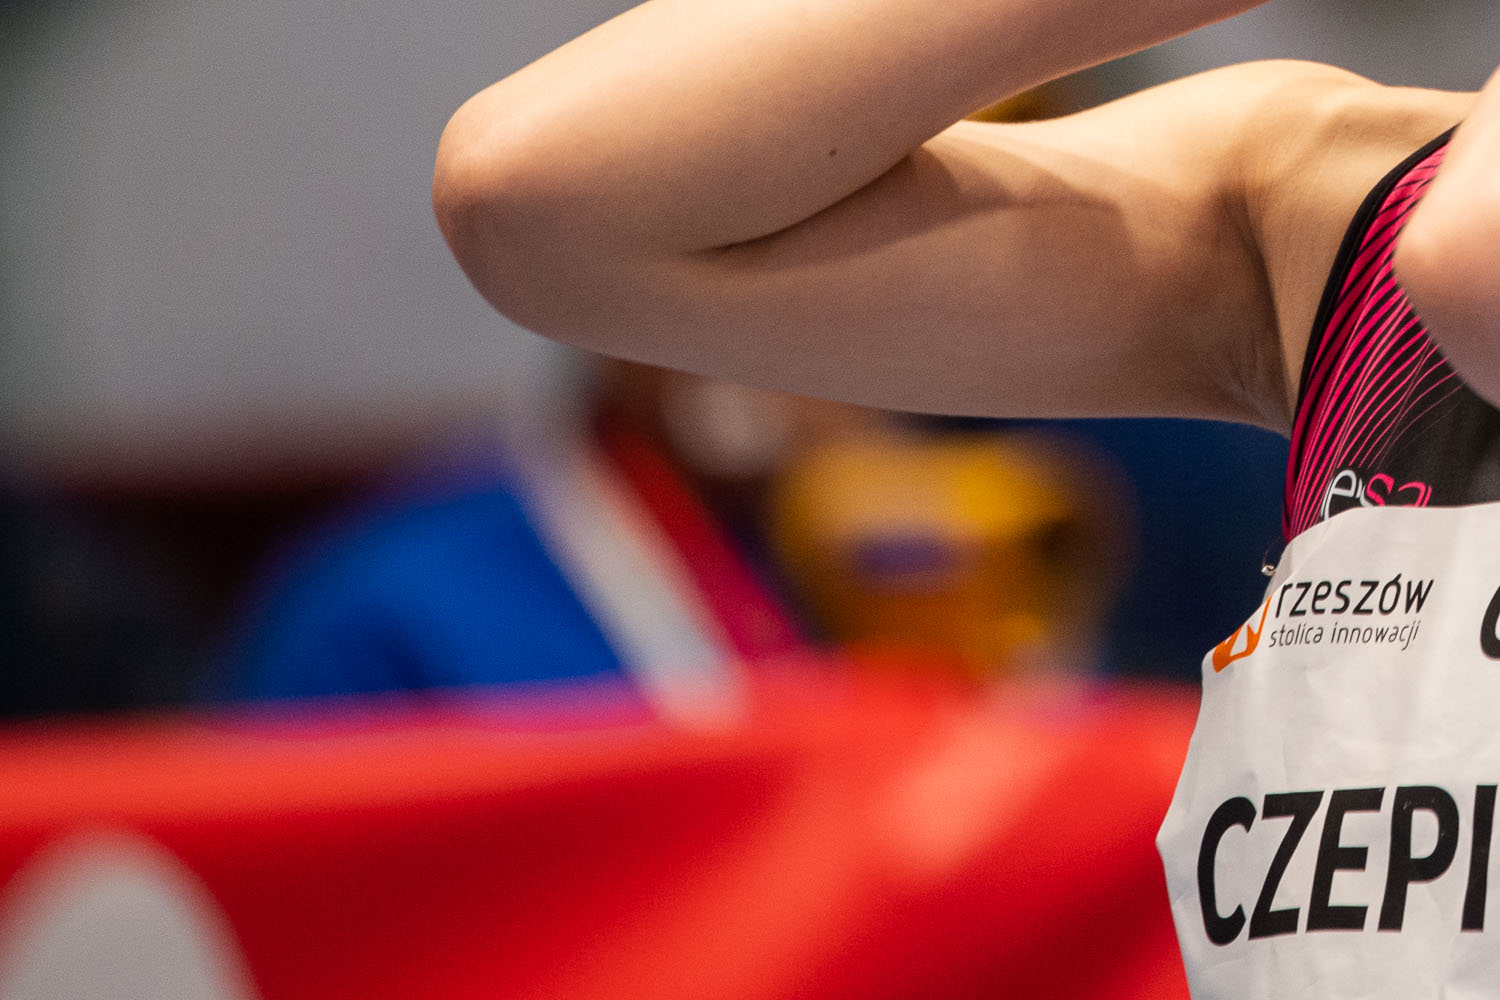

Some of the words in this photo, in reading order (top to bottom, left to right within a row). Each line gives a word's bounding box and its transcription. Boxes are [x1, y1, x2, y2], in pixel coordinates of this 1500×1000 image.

[1275, 573, 1434, 618] rzeszów
[1268, 623, 1323, 648] stolica
[1330, 620, 1421, 651] innowacji
